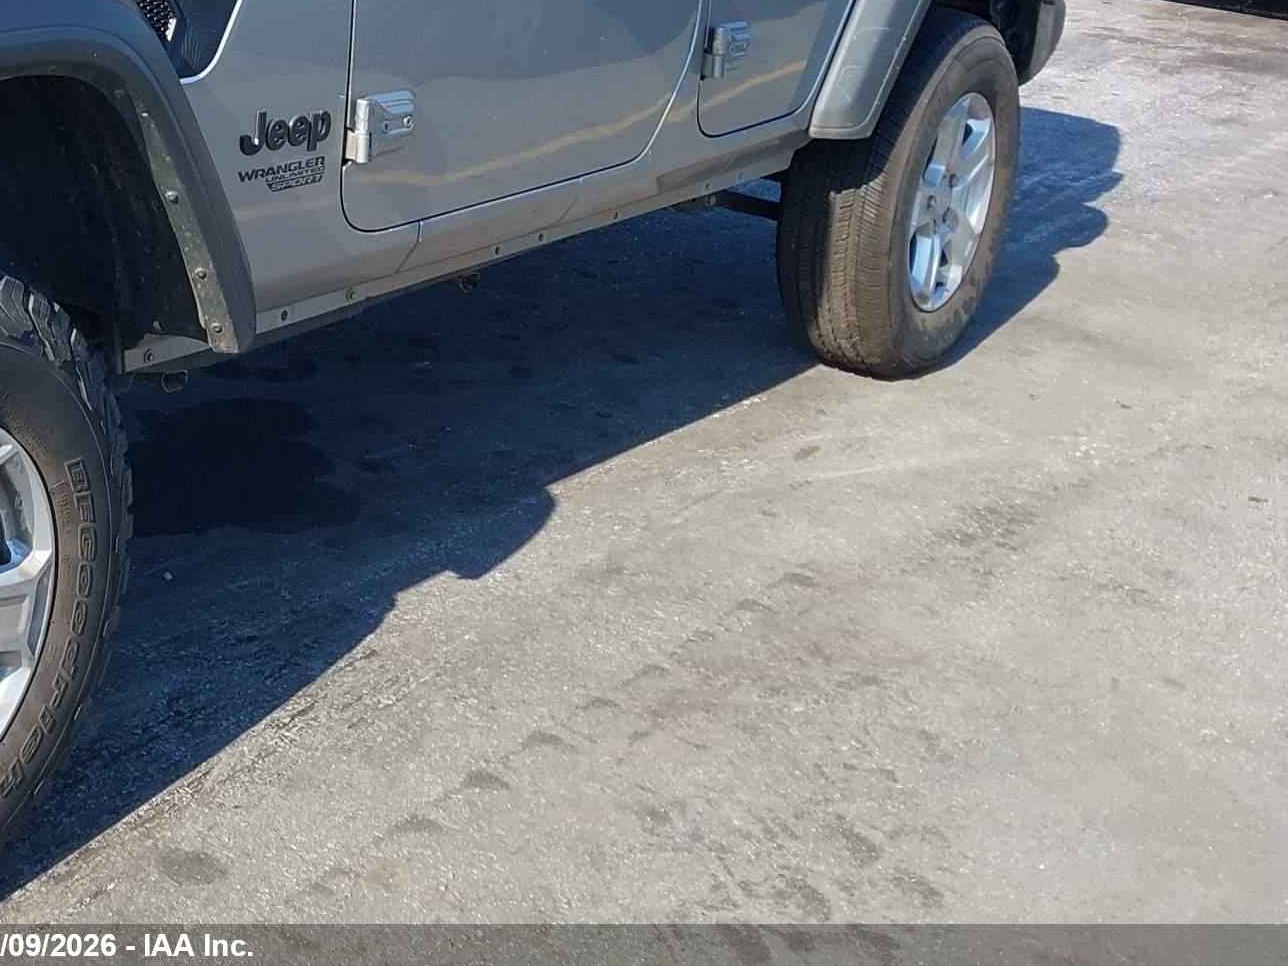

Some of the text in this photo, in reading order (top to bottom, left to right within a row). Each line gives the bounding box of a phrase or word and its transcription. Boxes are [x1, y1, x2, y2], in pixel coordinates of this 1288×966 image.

[239, 110, 331, 156] Jeep
[238, 156, 325, 183] WRANGLER
[266, 165, 325, 183] UNLIMITED
